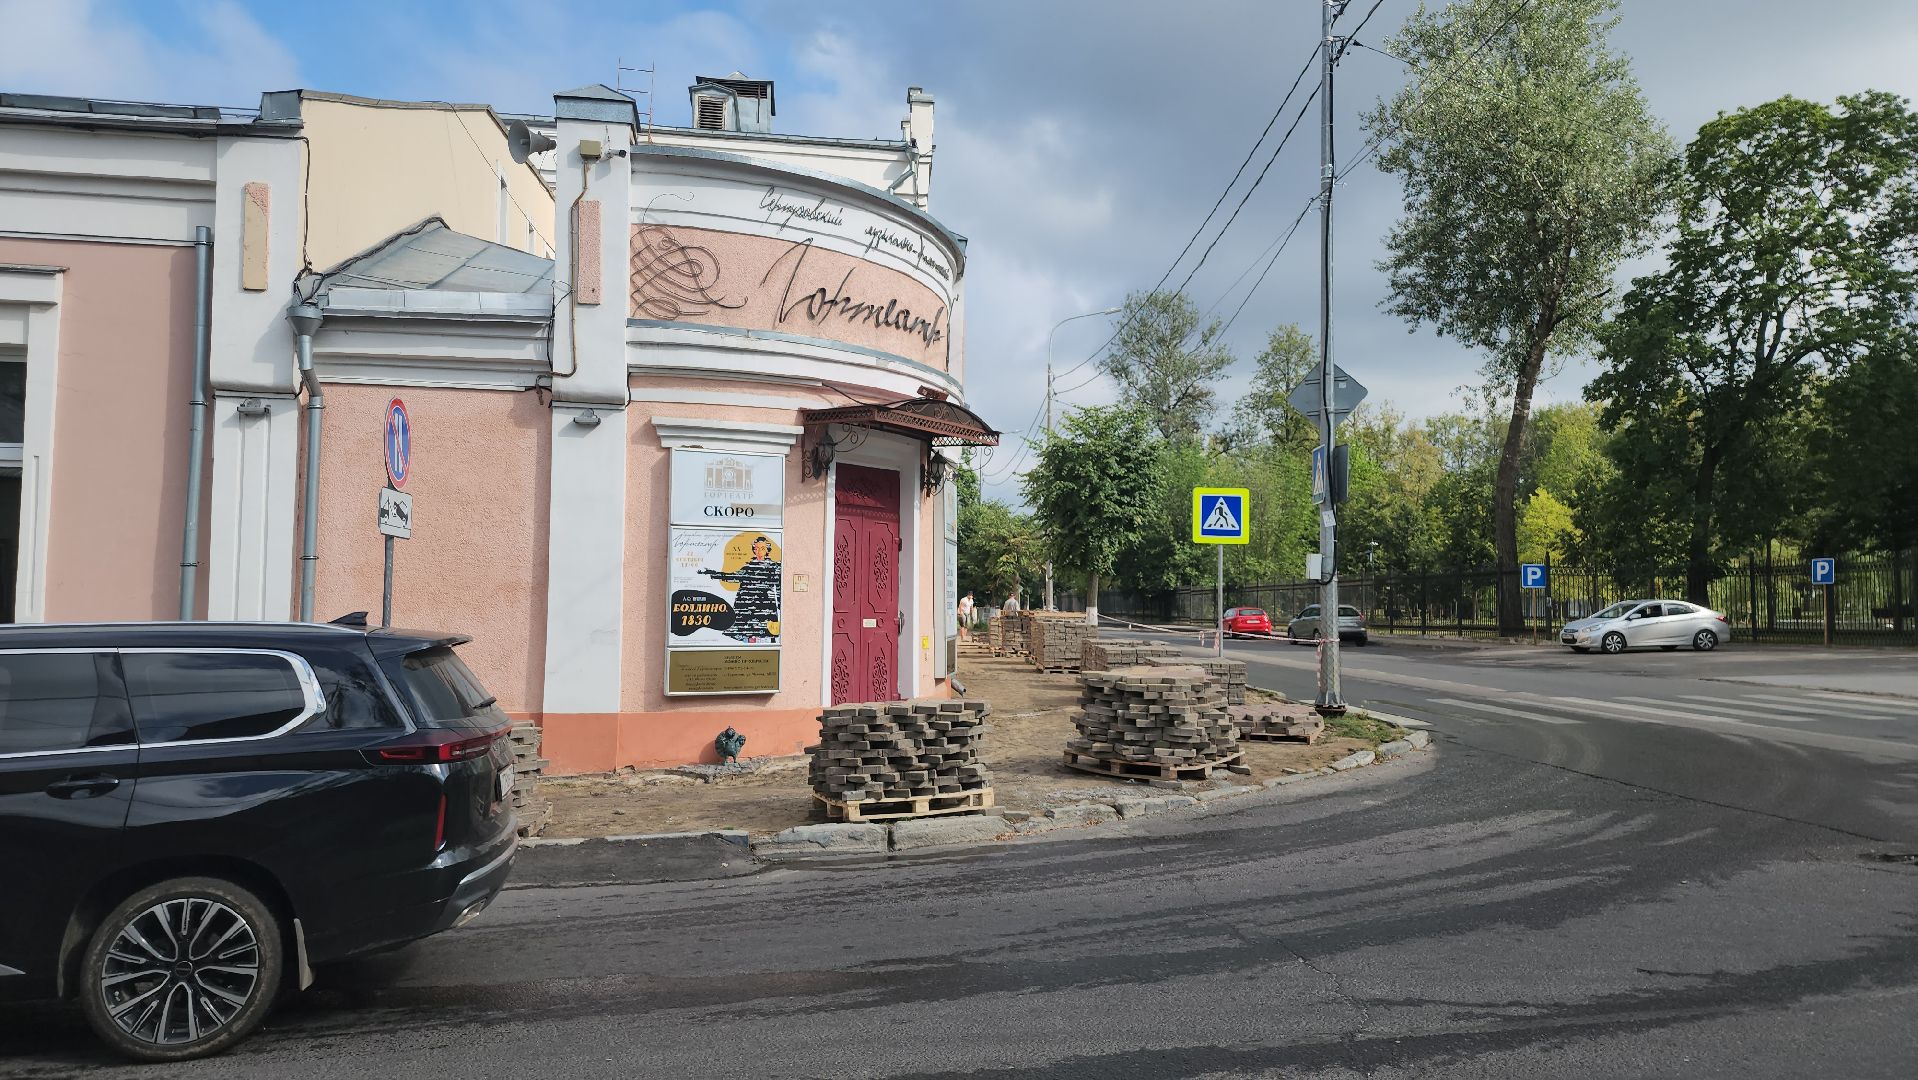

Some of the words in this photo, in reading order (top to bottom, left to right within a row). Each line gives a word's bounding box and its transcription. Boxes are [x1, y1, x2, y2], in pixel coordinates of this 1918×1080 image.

[703, 505, 754, 518] СКОРО
[1527, 567, 1542, 586] P
[1817, 561, 1830, 582] P
[681, 614, 712, 626] 1830
